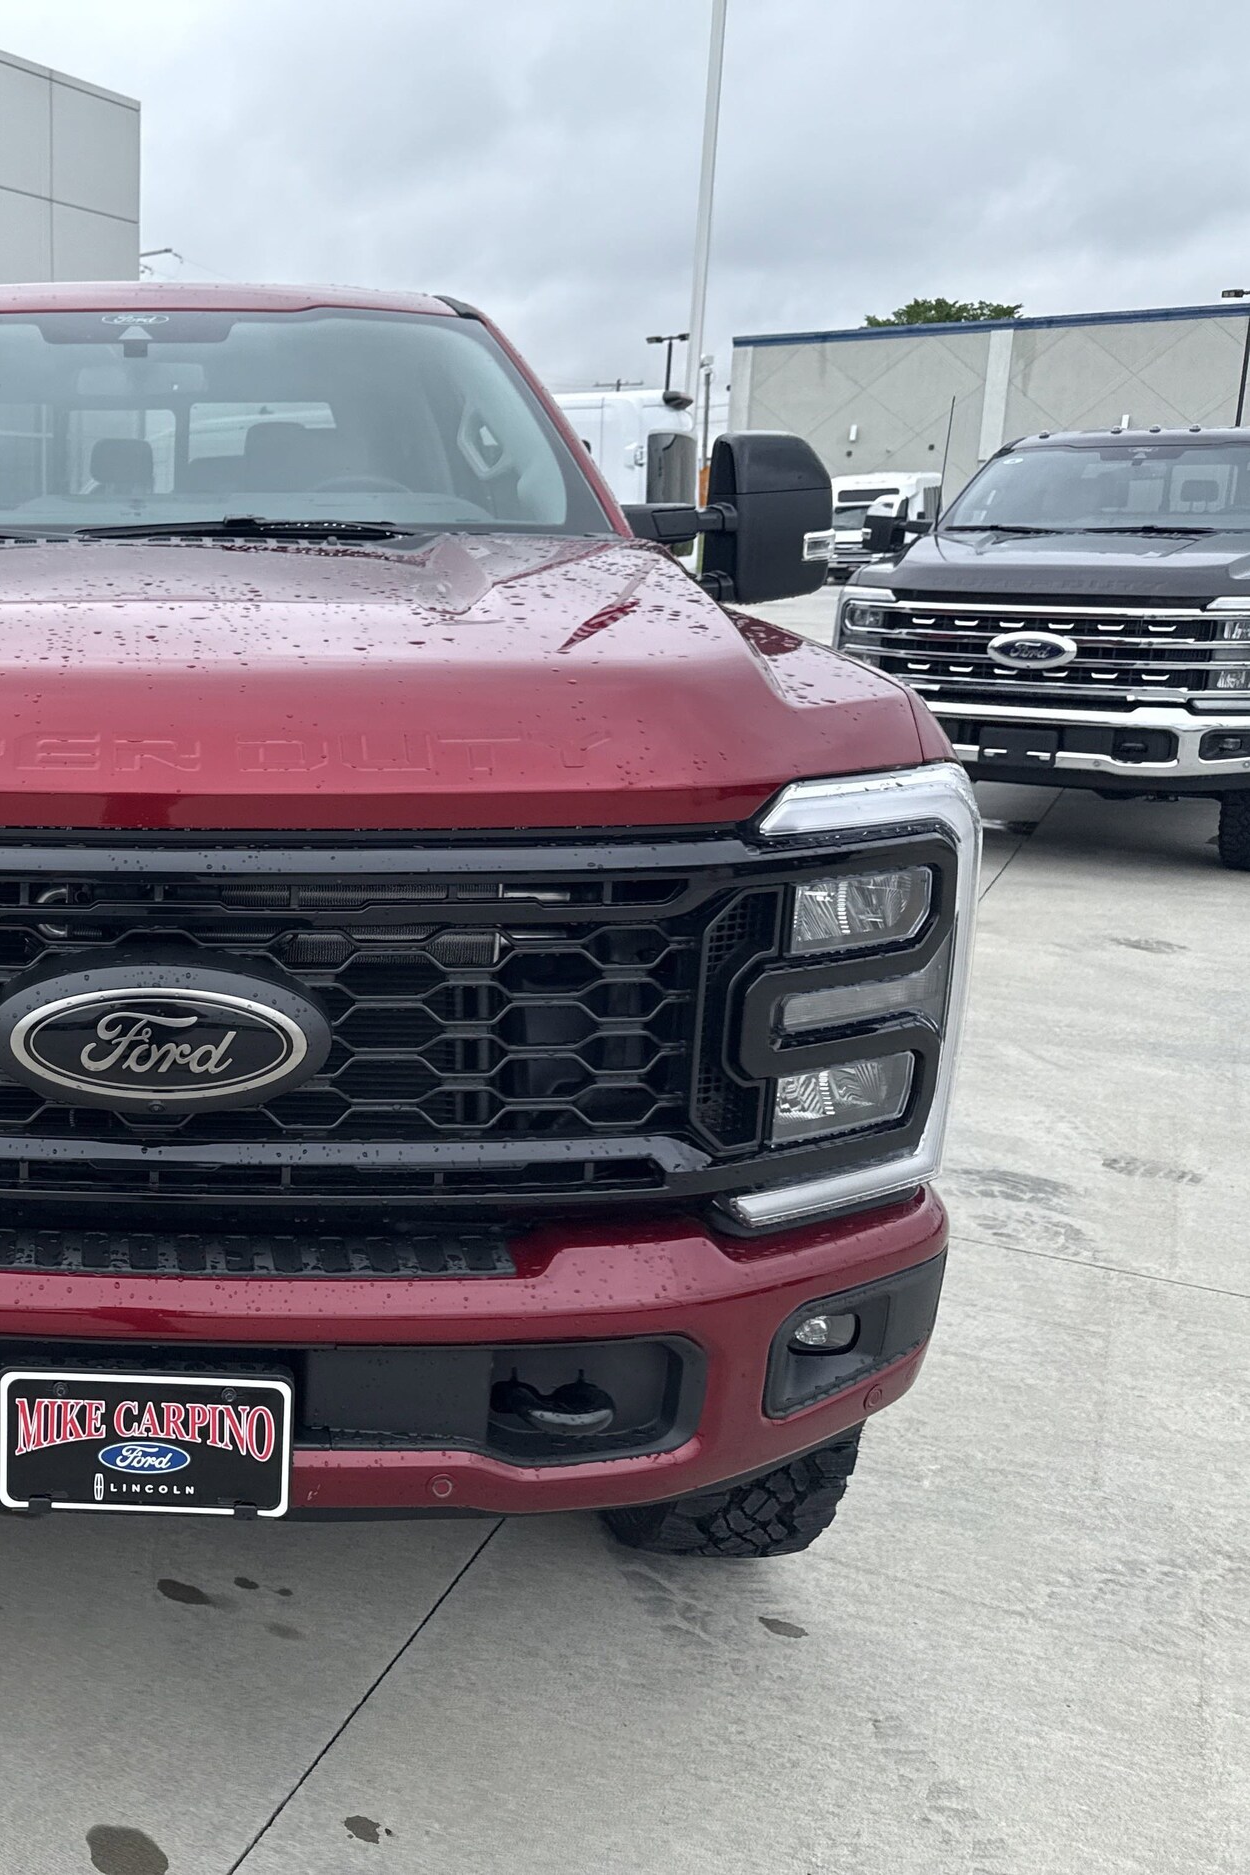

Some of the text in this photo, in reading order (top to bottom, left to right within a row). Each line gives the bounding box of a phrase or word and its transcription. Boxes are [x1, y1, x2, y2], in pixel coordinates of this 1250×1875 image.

[113, 315, 156, 324] Ford
[1010, 641, 1051, 658] Ford
[237, 730, 611, 771] DUTY
[80, 1011, 238, 1074] Ford
[15, 1398, 275, 1462] MIKE CARPINO
[116, 1445, 173, 1469] Ford
[110, 1482, 195, 1495] LINCOLN
